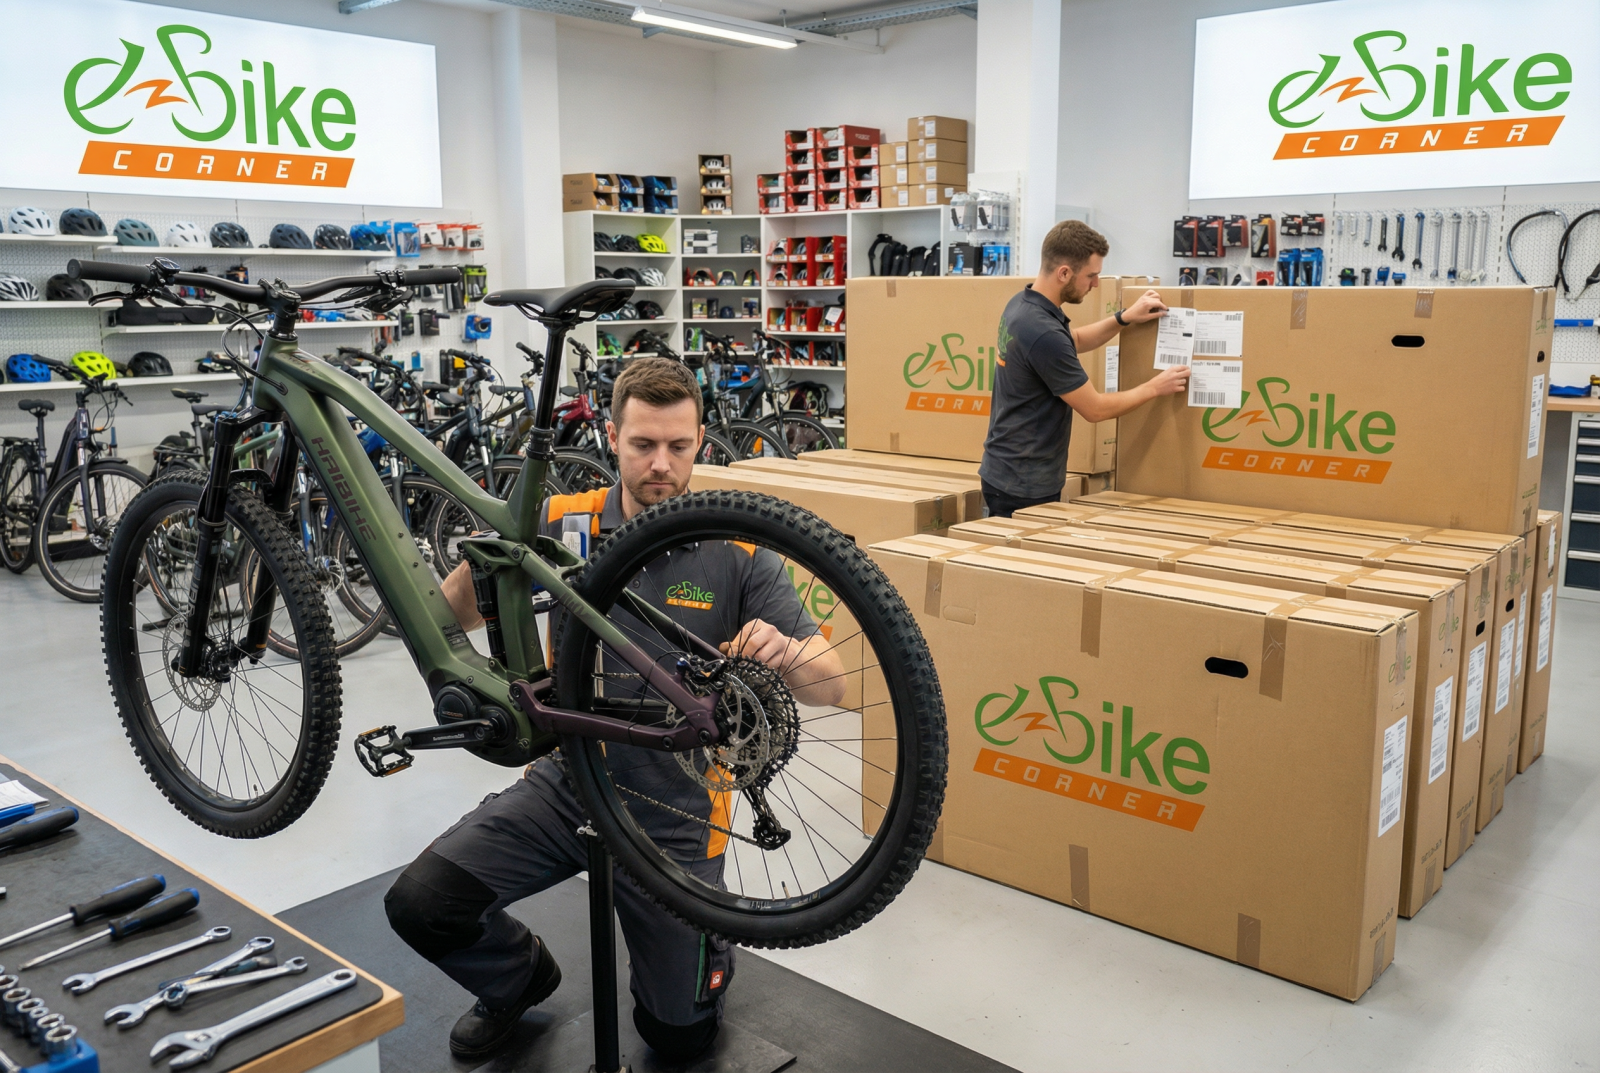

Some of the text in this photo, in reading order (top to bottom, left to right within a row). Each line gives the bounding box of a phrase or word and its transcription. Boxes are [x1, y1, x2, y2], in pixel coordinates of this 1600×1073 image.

[1302, 124, 1529, 154] CORNER
[112, 149, 328, 181] CORNER
[916, 396, 984, 412] CORN
[1218, 452, 1371, 478] CORNER
[993, 757, 1178, 821] CORNER
